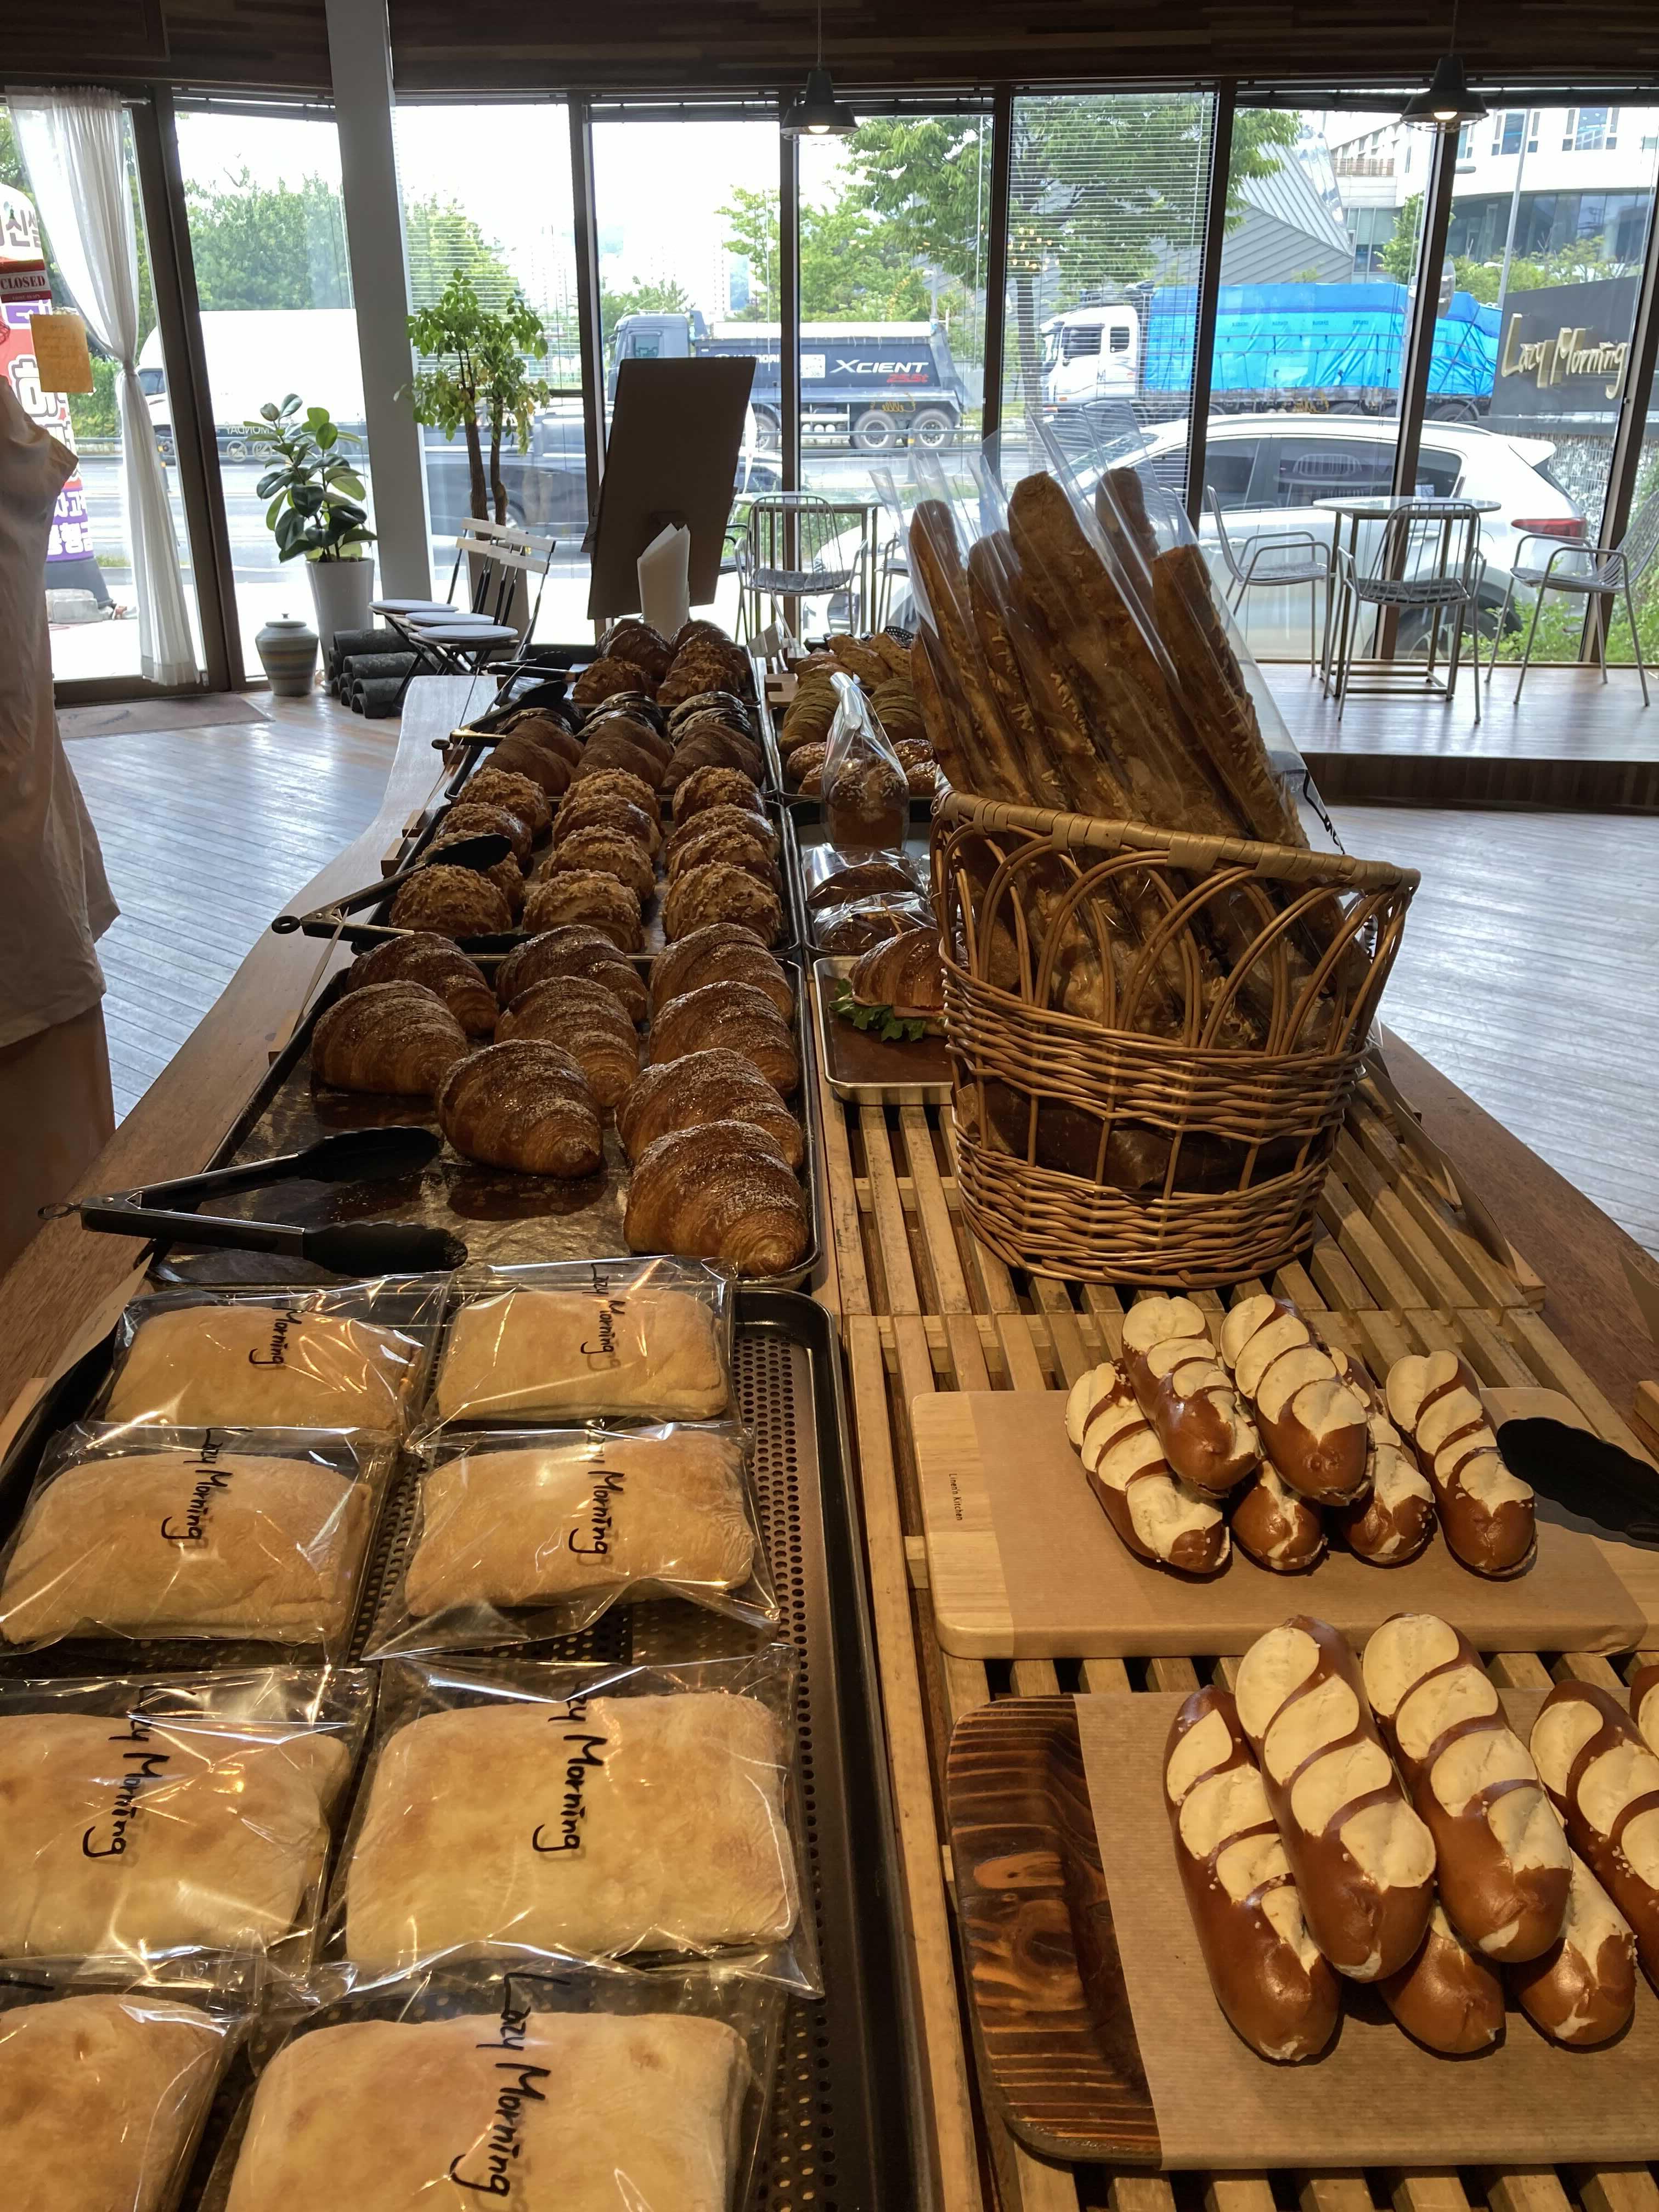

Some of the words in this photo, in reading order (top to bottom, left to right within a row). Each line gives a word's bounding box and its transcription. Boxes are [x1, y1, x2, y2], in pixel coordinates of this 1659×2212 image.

[1, 275, 46, 290] CLOSED
[1501, 313, 1555, 388] Lazy
[1550, 327, 1628, 399] Morning
[582, 1263, 630, 1295] Lazy
[249, 1307, 307, 1364] Morning
[580, 1300, 626, 1355] Morning
[183, 1427, 254, 1464] Lazy
[161, 1470, 233, 1539] Morning
[568, 1471, 625, 1554] Morning
[953, 1497, 963, 1521] Kitchen
[83, 1753, 170, 1858] Morning
[532, 1735, 608, 1852] Morning
[476, 1972, 571, 2051] Lazy
[449, 2063, 551, 2197] Morning
